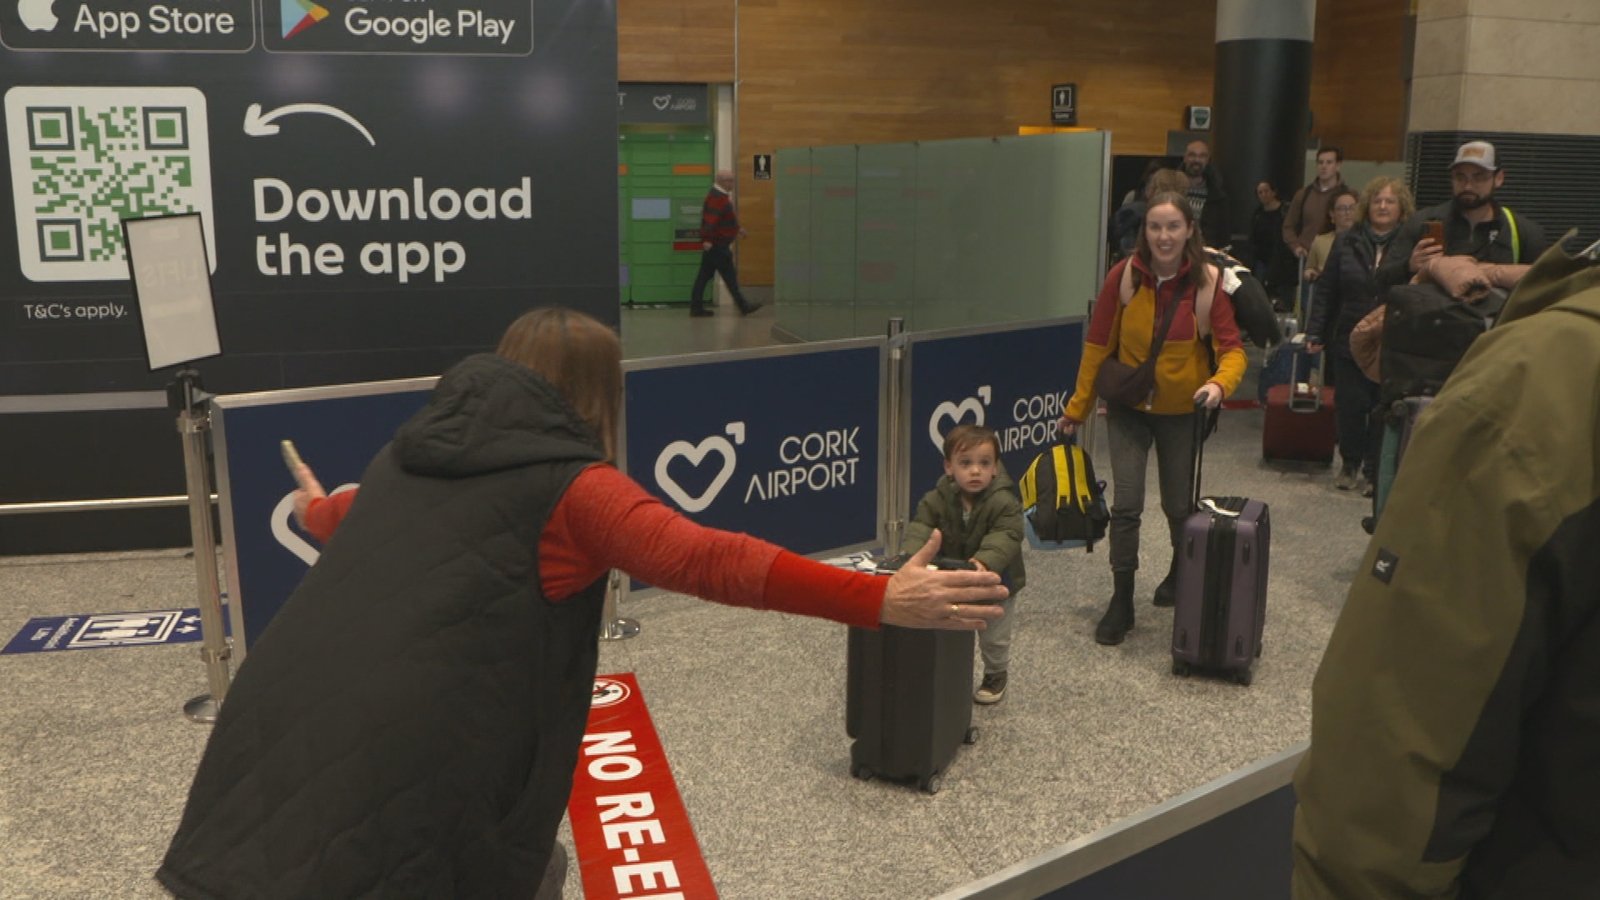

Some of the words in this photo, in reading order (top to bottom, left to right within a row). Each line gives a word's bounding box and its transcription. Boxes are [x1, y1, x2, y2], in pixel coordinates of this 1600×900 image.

[73, 4, 141, 39] App
[149, 5, 235, 34] Store
[344, 7, 451, 44] Google
[458, 9, 515, 45] Play
[253, 176, 532, 222] Download
[256, 232, 344, 275] the
[359, 241, 466, 283] app
[23, 303, 72, 320] T&C's
[75, 302, 128, 320] apply.
[1013, 389, 1067, 422] CORK
[780, 426, 860, 464] CORK
[994, 420, 1058, 454] IRPOR
[744, 458, 860, 504] AIRPORT
[581, 730, 643, 781] NO
[595, 792, 686, 900] RE-E
